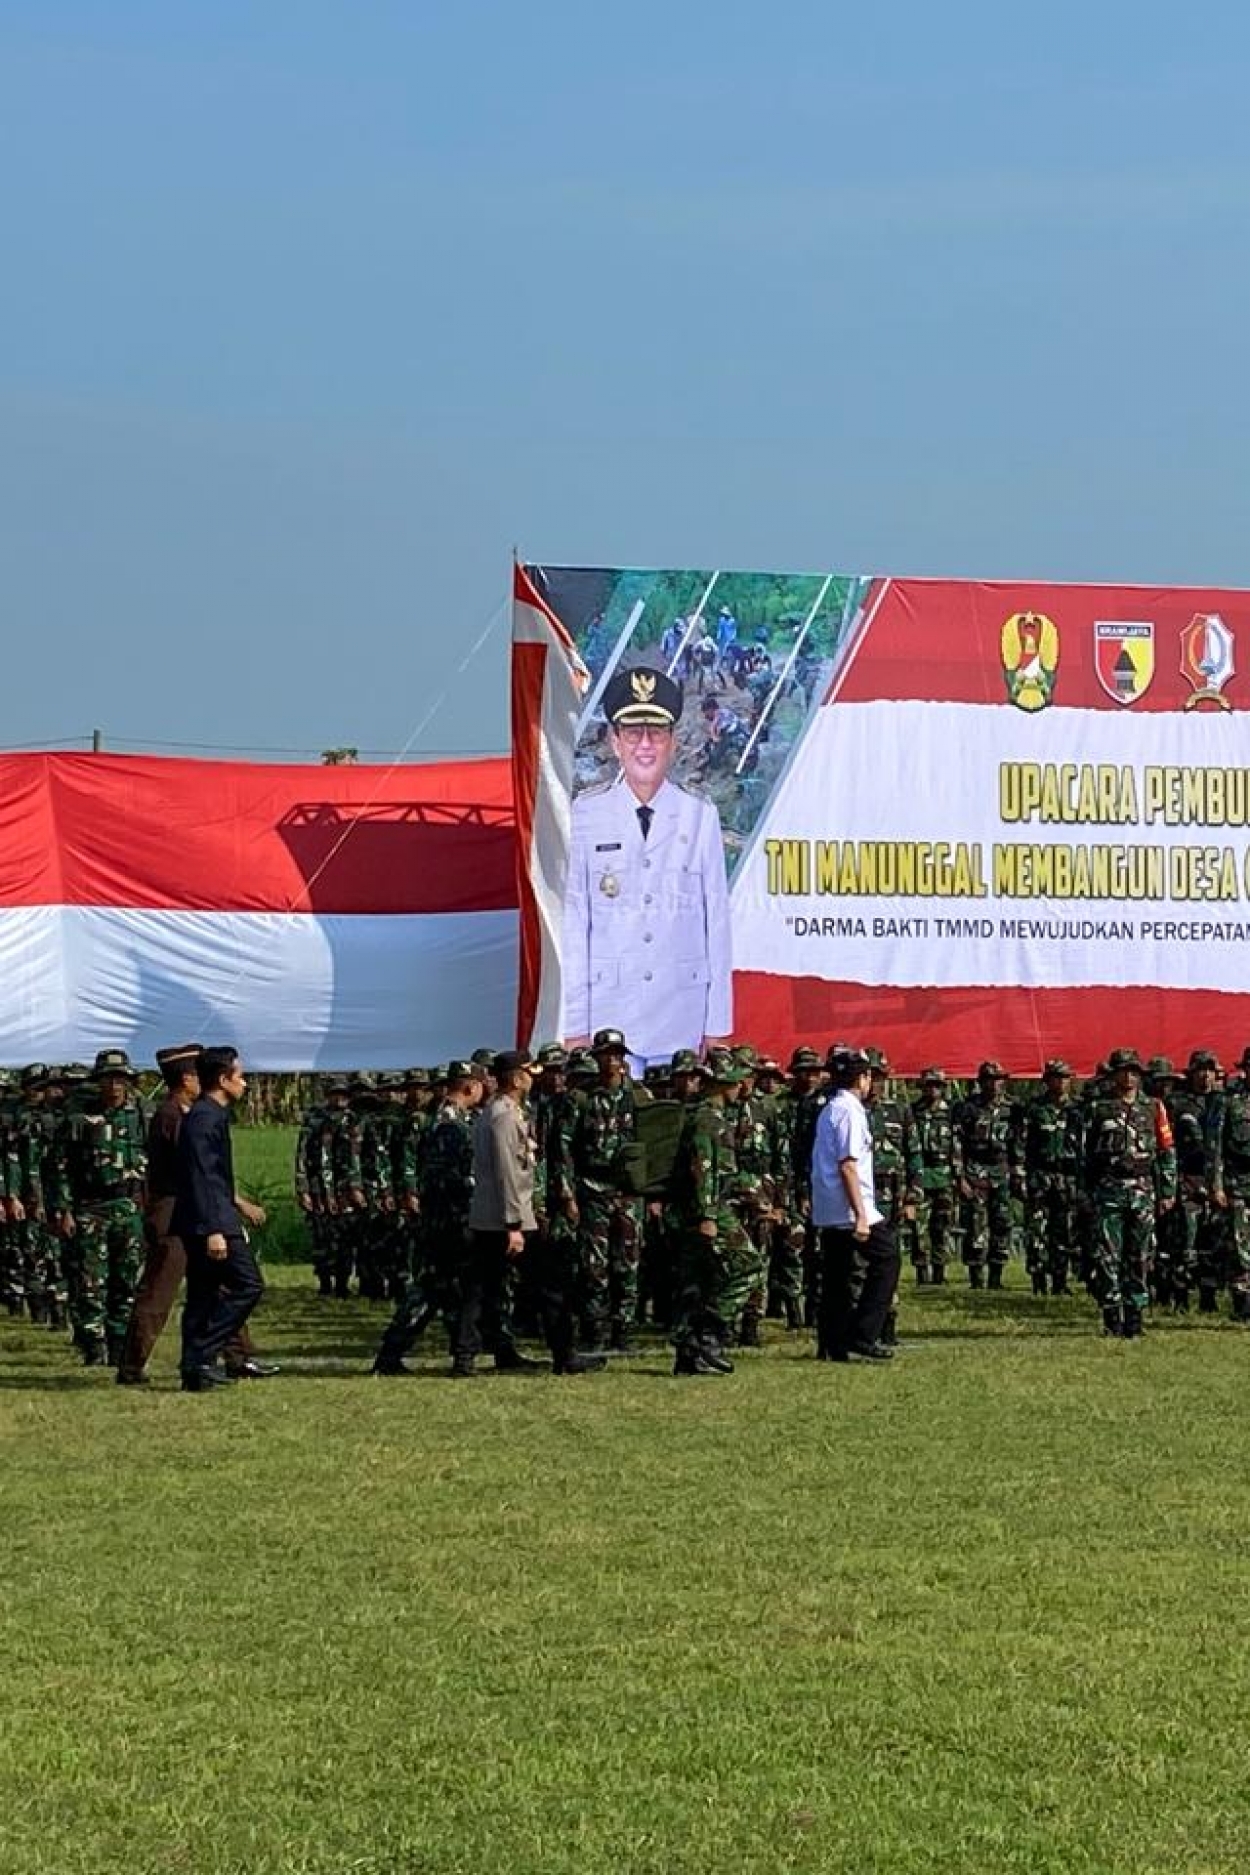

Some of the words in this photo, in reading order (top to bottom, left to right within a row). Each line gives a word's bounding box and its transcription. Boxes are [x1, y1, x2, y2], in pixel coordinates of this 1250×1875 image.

[1000, 763, 1138, 824] UPACARA
[765, 839, 811, 895] TNI
[816, 840, 988, 898] MANUNGGAL
[992, 843, 1165, 900] MEMBANGUN
[1170, 846, 1239, 901] DESA
[785, 917, 867, 938] "DARMA
[873, 918, 929, 938] BAKTI
[934, 919, 994, 938] TMMD
[1000, 920, 1134, 940] MEWUJUDKAN
